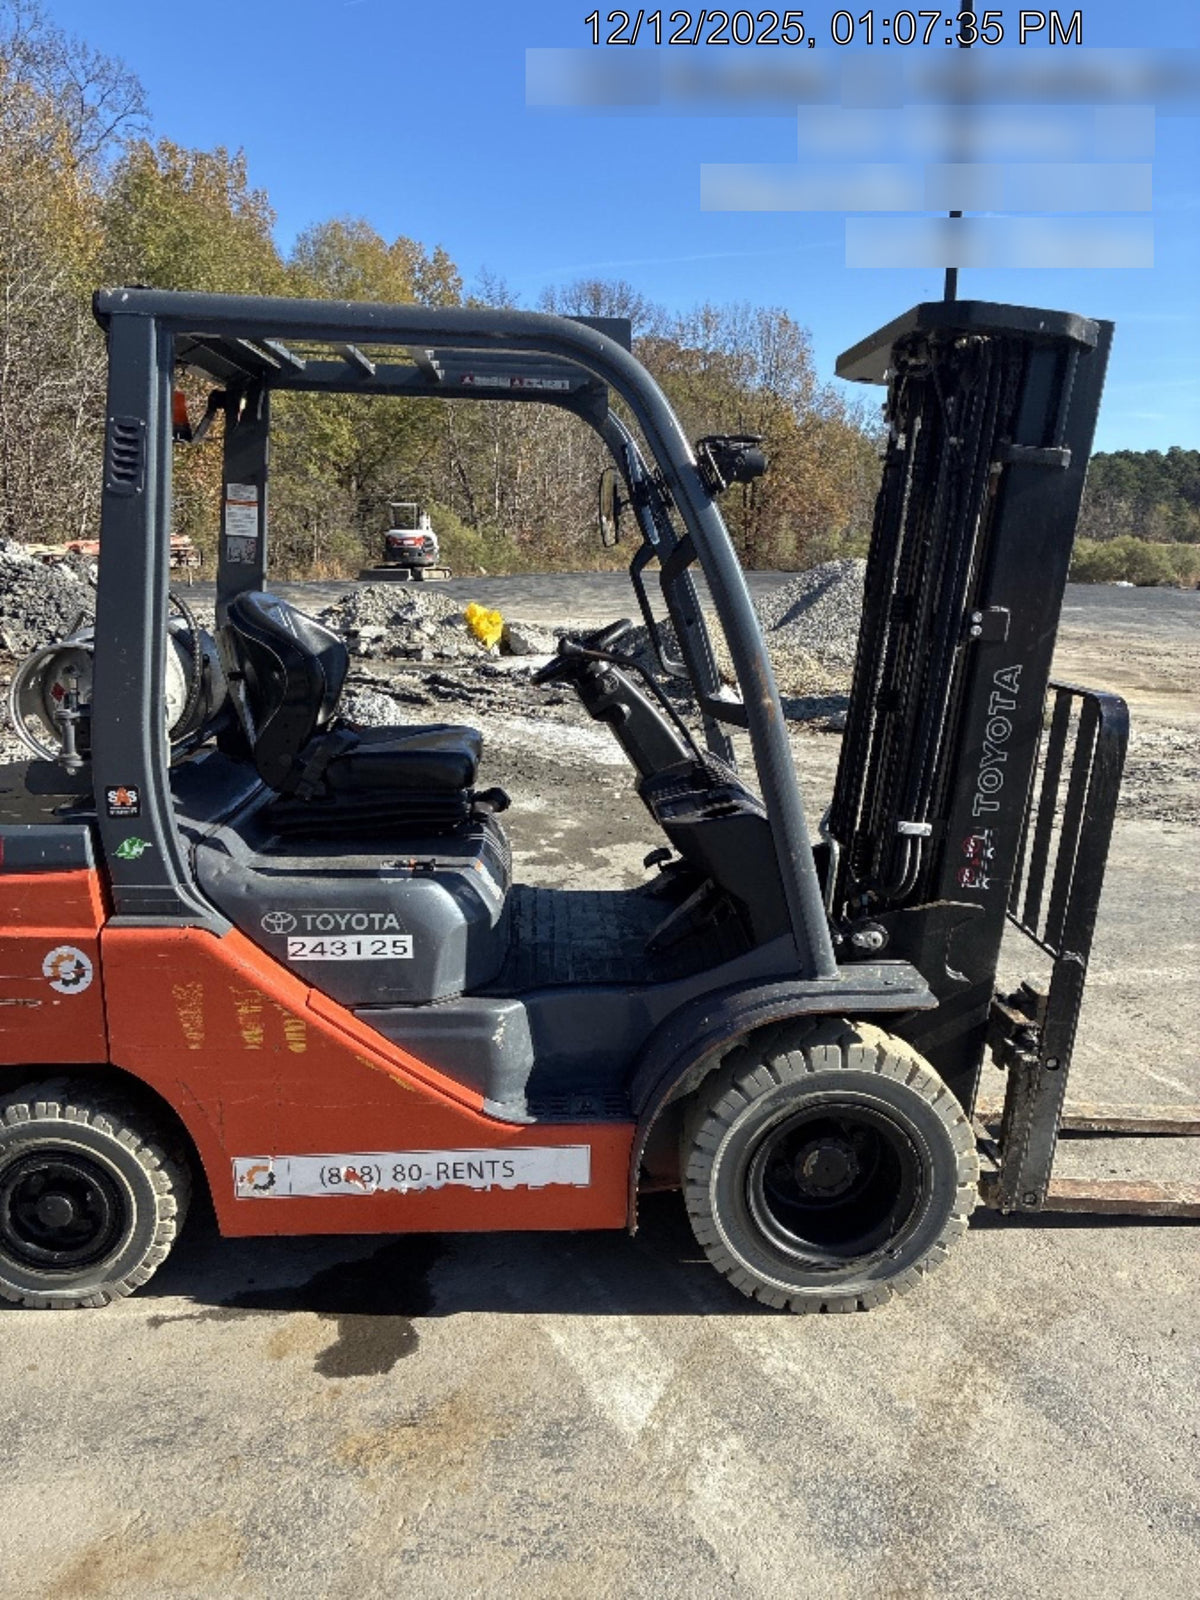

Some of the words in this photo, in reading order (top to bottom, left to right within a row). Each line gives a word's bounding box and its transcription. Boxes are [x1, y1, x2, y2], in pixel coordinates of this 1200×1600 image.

[971, 664, 1024, 817] TOYOTA
[301, 913, 401, 931] TOYOTA
[288, 940, 408, 958] 243125
[391, 1160, 515, 1182] 80-RENTS
